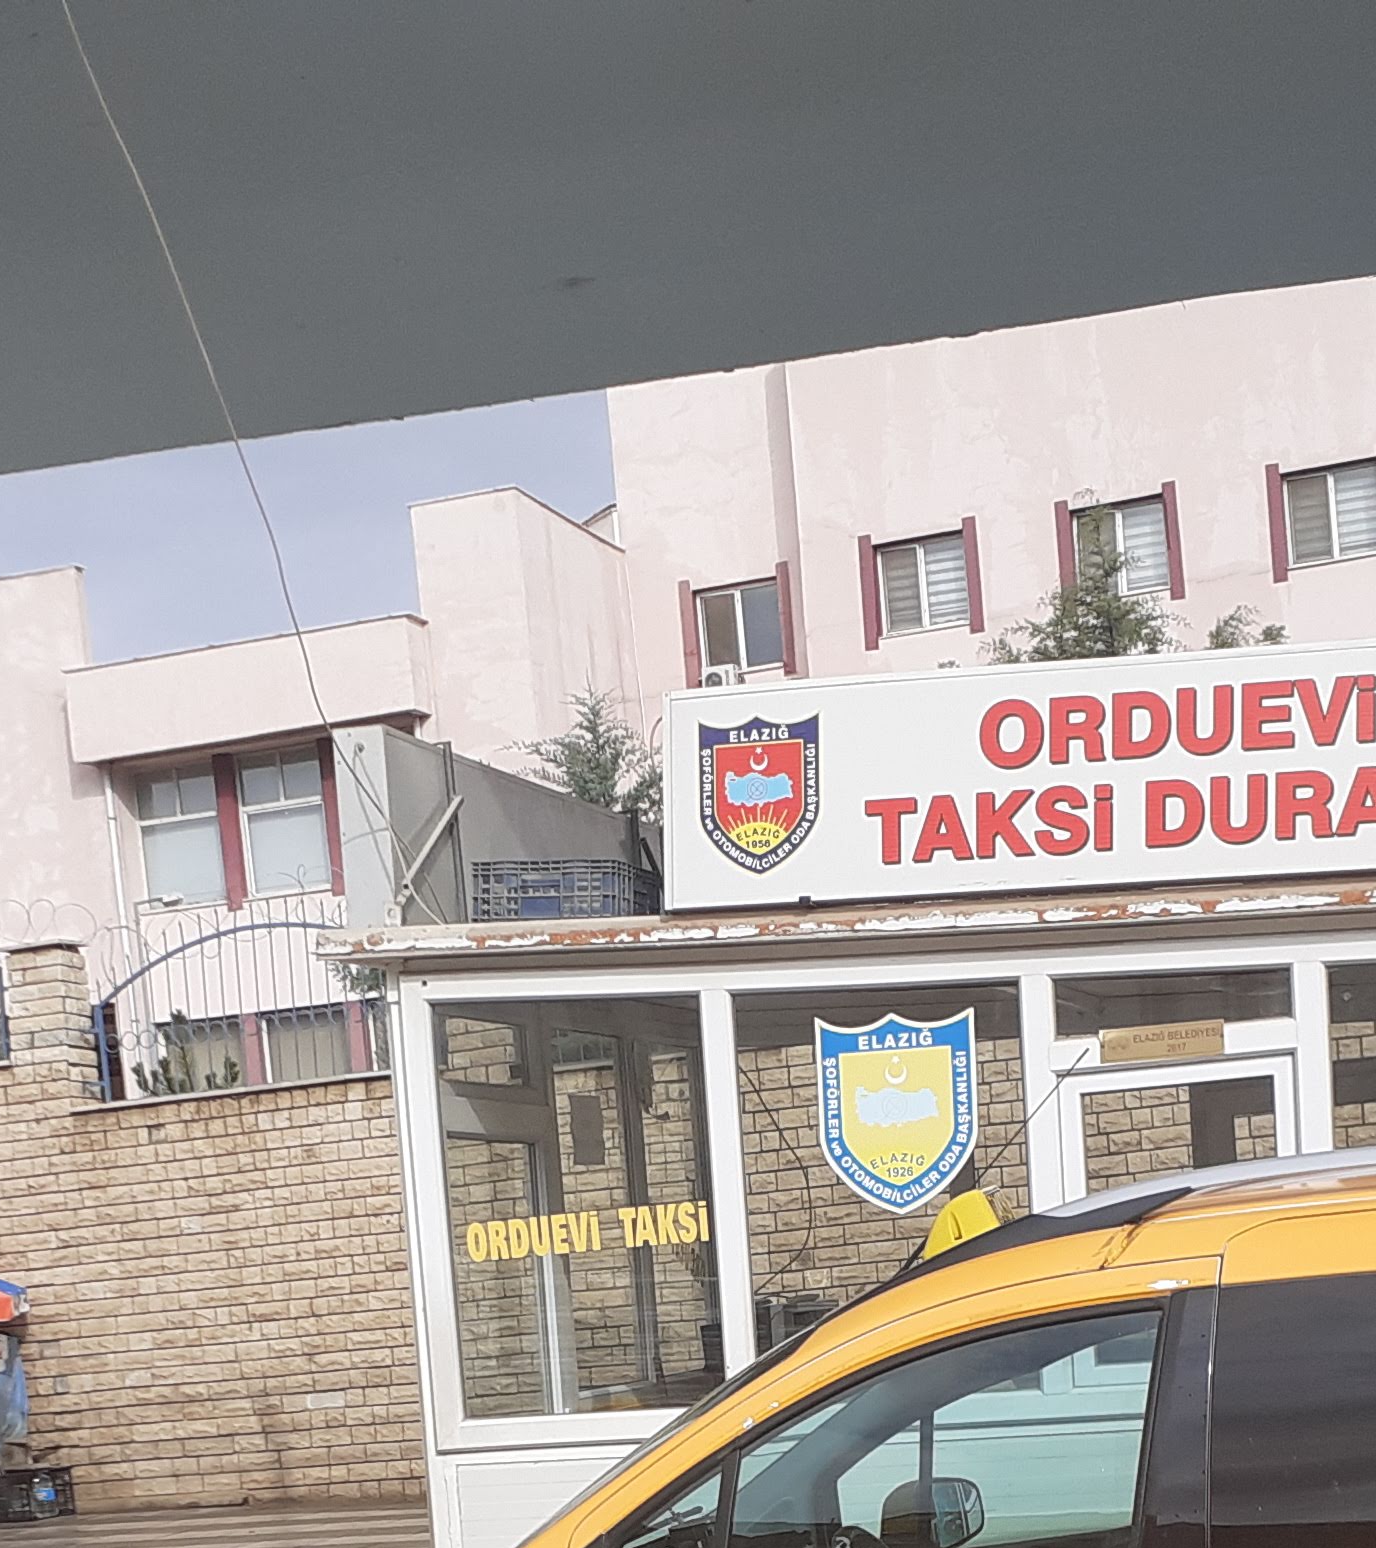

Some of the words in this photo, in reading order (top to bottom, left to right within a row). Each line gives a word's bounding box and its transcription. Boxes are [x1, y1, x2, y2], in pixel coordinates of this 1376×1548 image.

[729, 723, 789, 742] ELAZIĞ
[791, 821, 811, 843] ODA
[858, 1028, 933, 1050] ELAZIĞ
[823, 1058, 840, 1139] ŞOFÖRLER
[831, 1141, 842, 1156] ve
[939, 1145, 962, 1172] ODA
[886, 1167, 913, 1178] 1926
